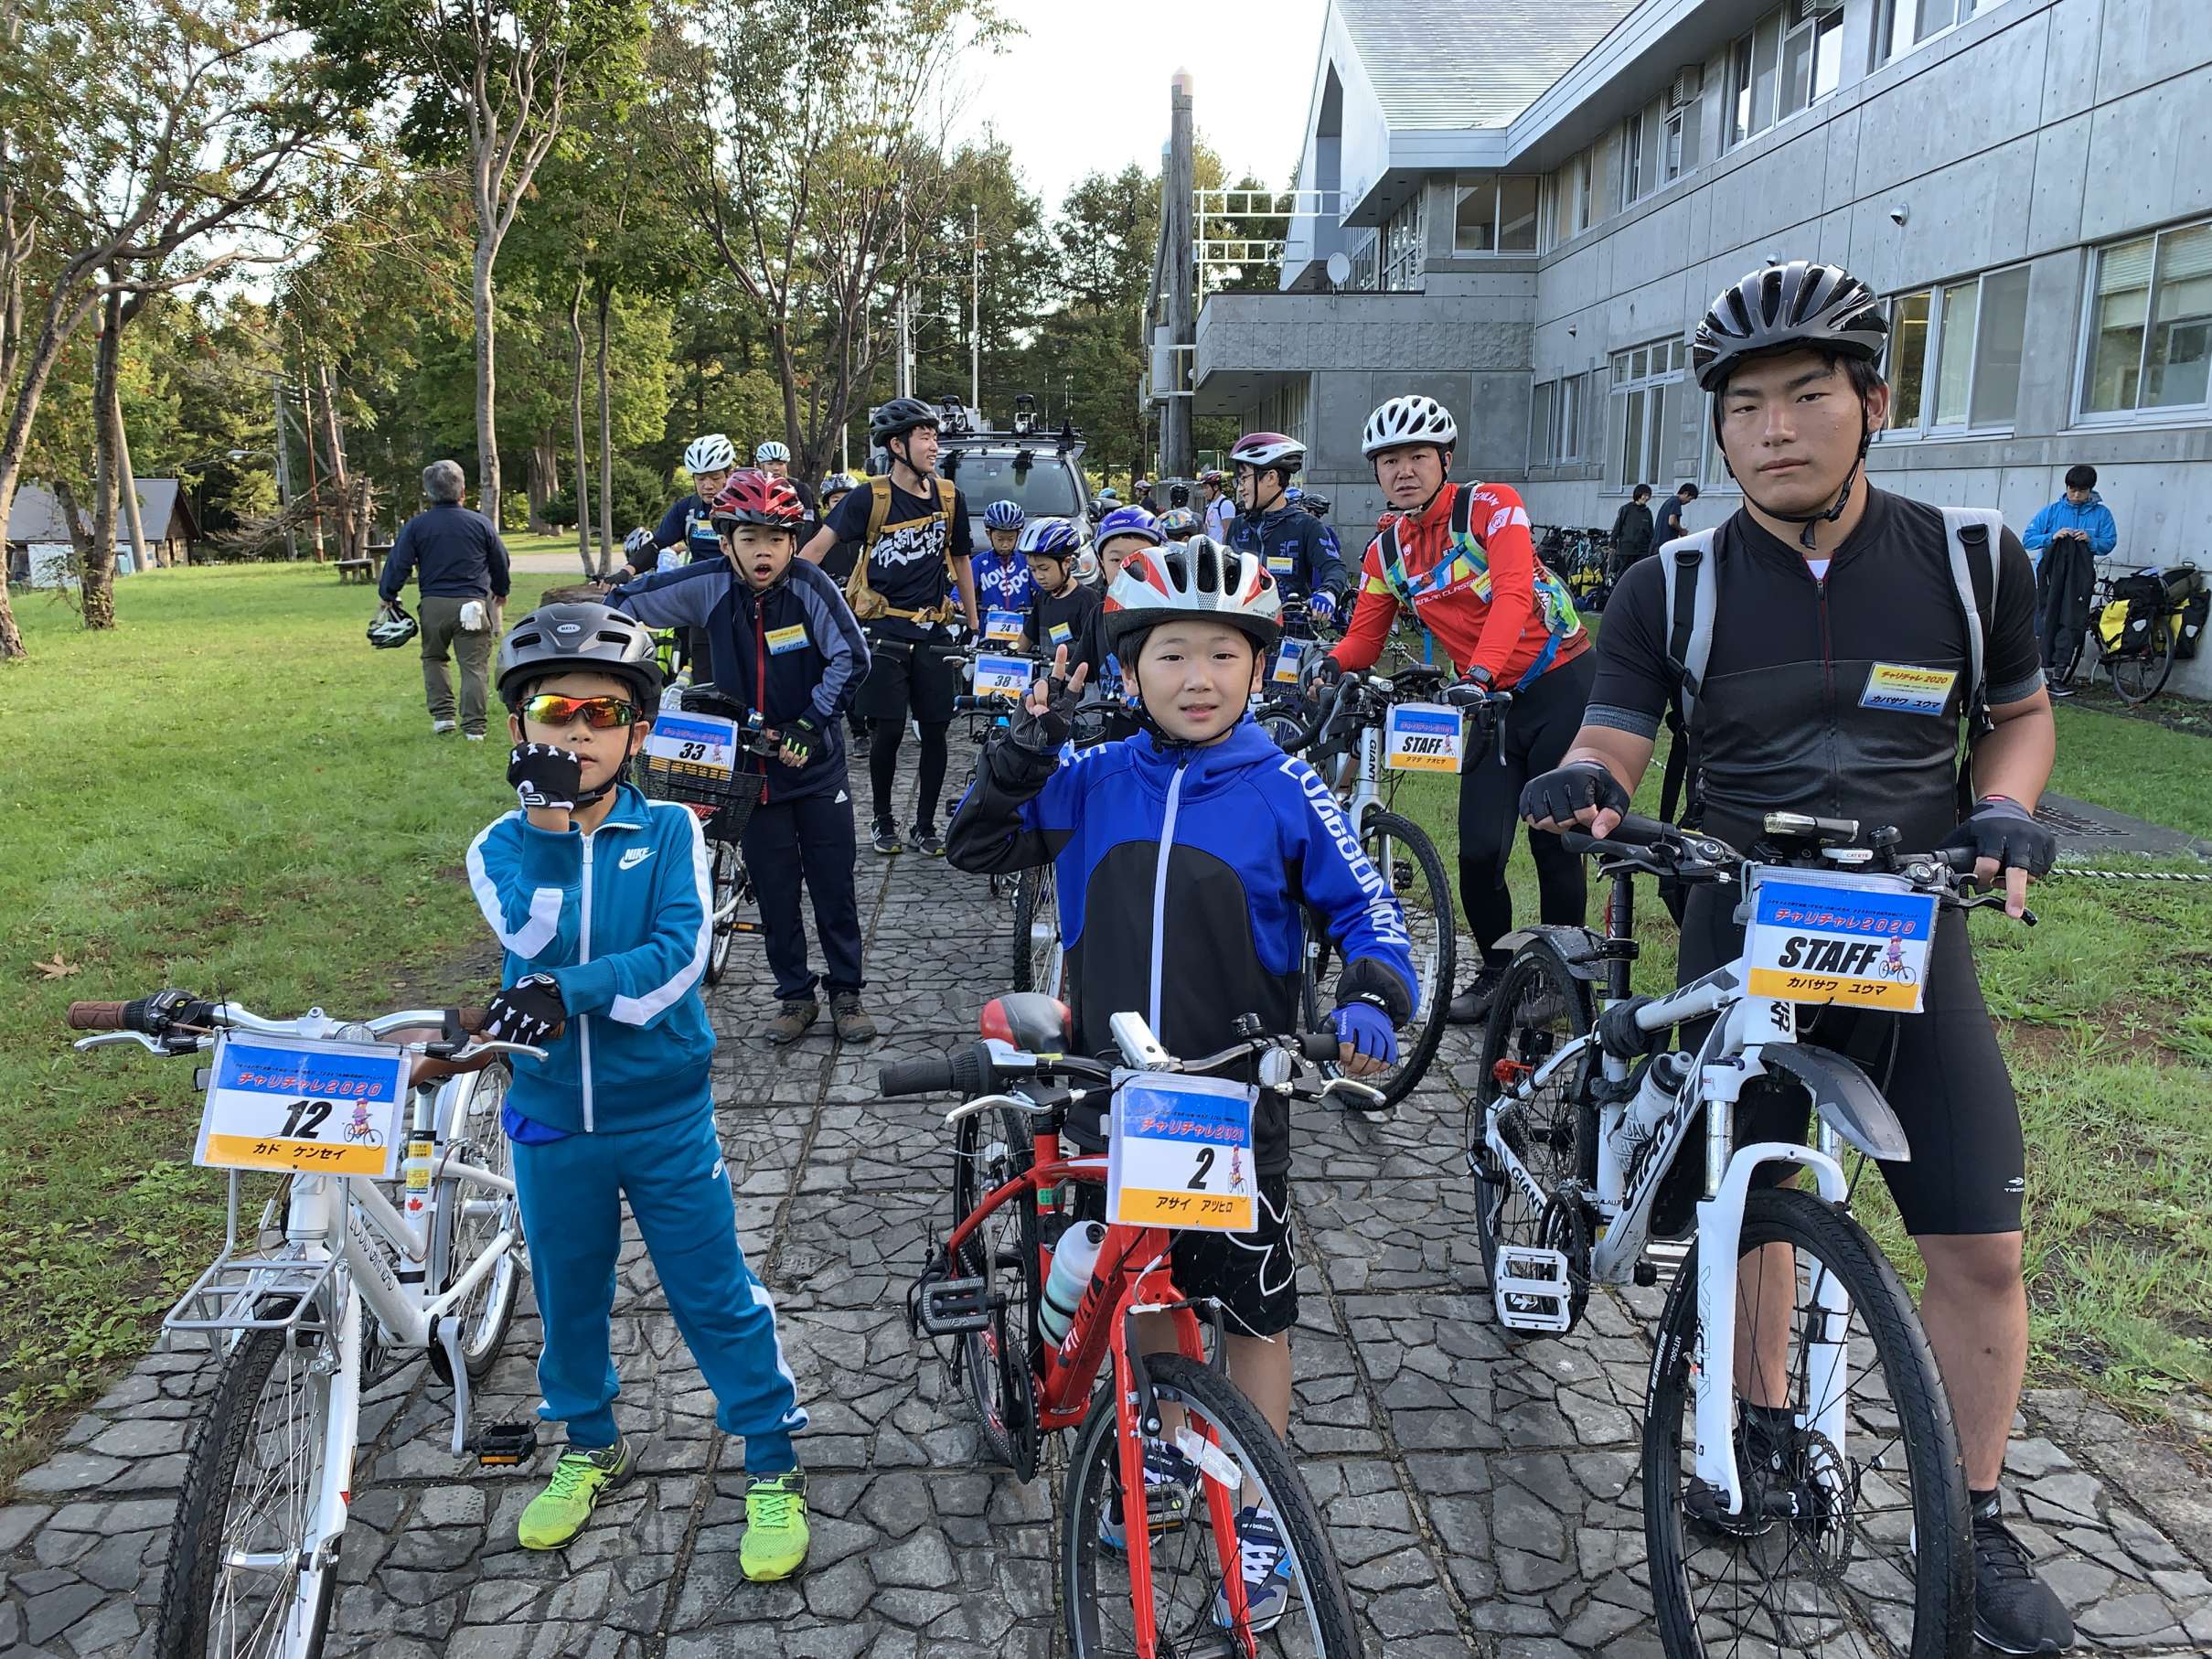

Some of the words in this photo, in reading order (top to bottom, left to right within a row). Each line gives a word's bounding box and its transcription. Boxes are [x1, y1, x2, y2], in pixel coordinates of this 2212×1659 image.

[1000, 624, 1011, 632] 24
[994, 675, 1011, 687] 38
[679, 743, 706, 760] 33
[1402, 736, 1443, 754] STAFF
[624, 847, 650, 861] NIKE
[1775, 908, 1917, 934] チャリチャレ2020
[1778, 936, 1884, 975] STAFF
[1786, 977, 1839, 991] カバサワ
[1847, 983, 1888, 995] ユウマ
[236, 1071, 383, 1097] チャリチャレ2020
[278, 1100, 333, 1139] 12
[252, 1142, 282, 1155] カド
[293, 1145, 347, 1160] ケンセイ
[1186, 1147, 1215, 1190] 2
[1511, 1166, 1544, 1215] GIANT
[1155, 1196, 1191, 1210] アサイ
[1201, 1199, 1234, 1213] アツヒロ
